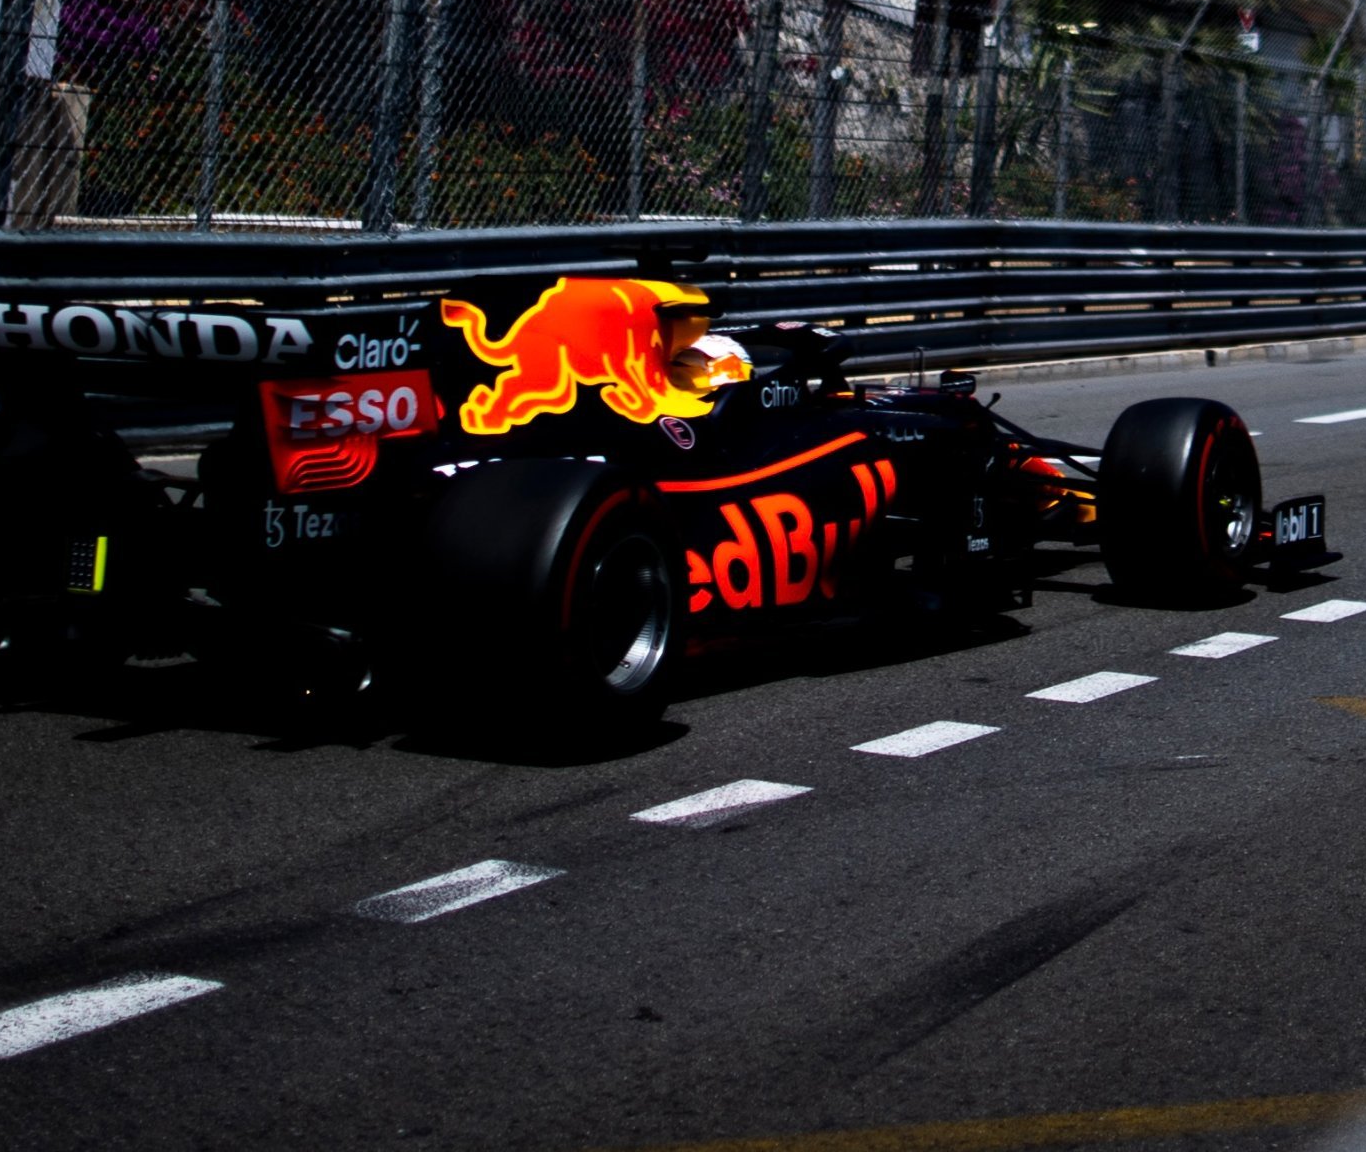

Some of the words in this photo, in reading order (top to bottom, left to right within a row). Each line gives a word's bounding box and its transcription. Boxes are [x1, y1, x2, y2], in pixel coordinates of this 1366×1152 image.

[334, 333, 409, 370] Claro
[289, 385, 419, 440] ESSO
[760, 379, 802, 408] citrix
[685, 502, 763, 614] ed
